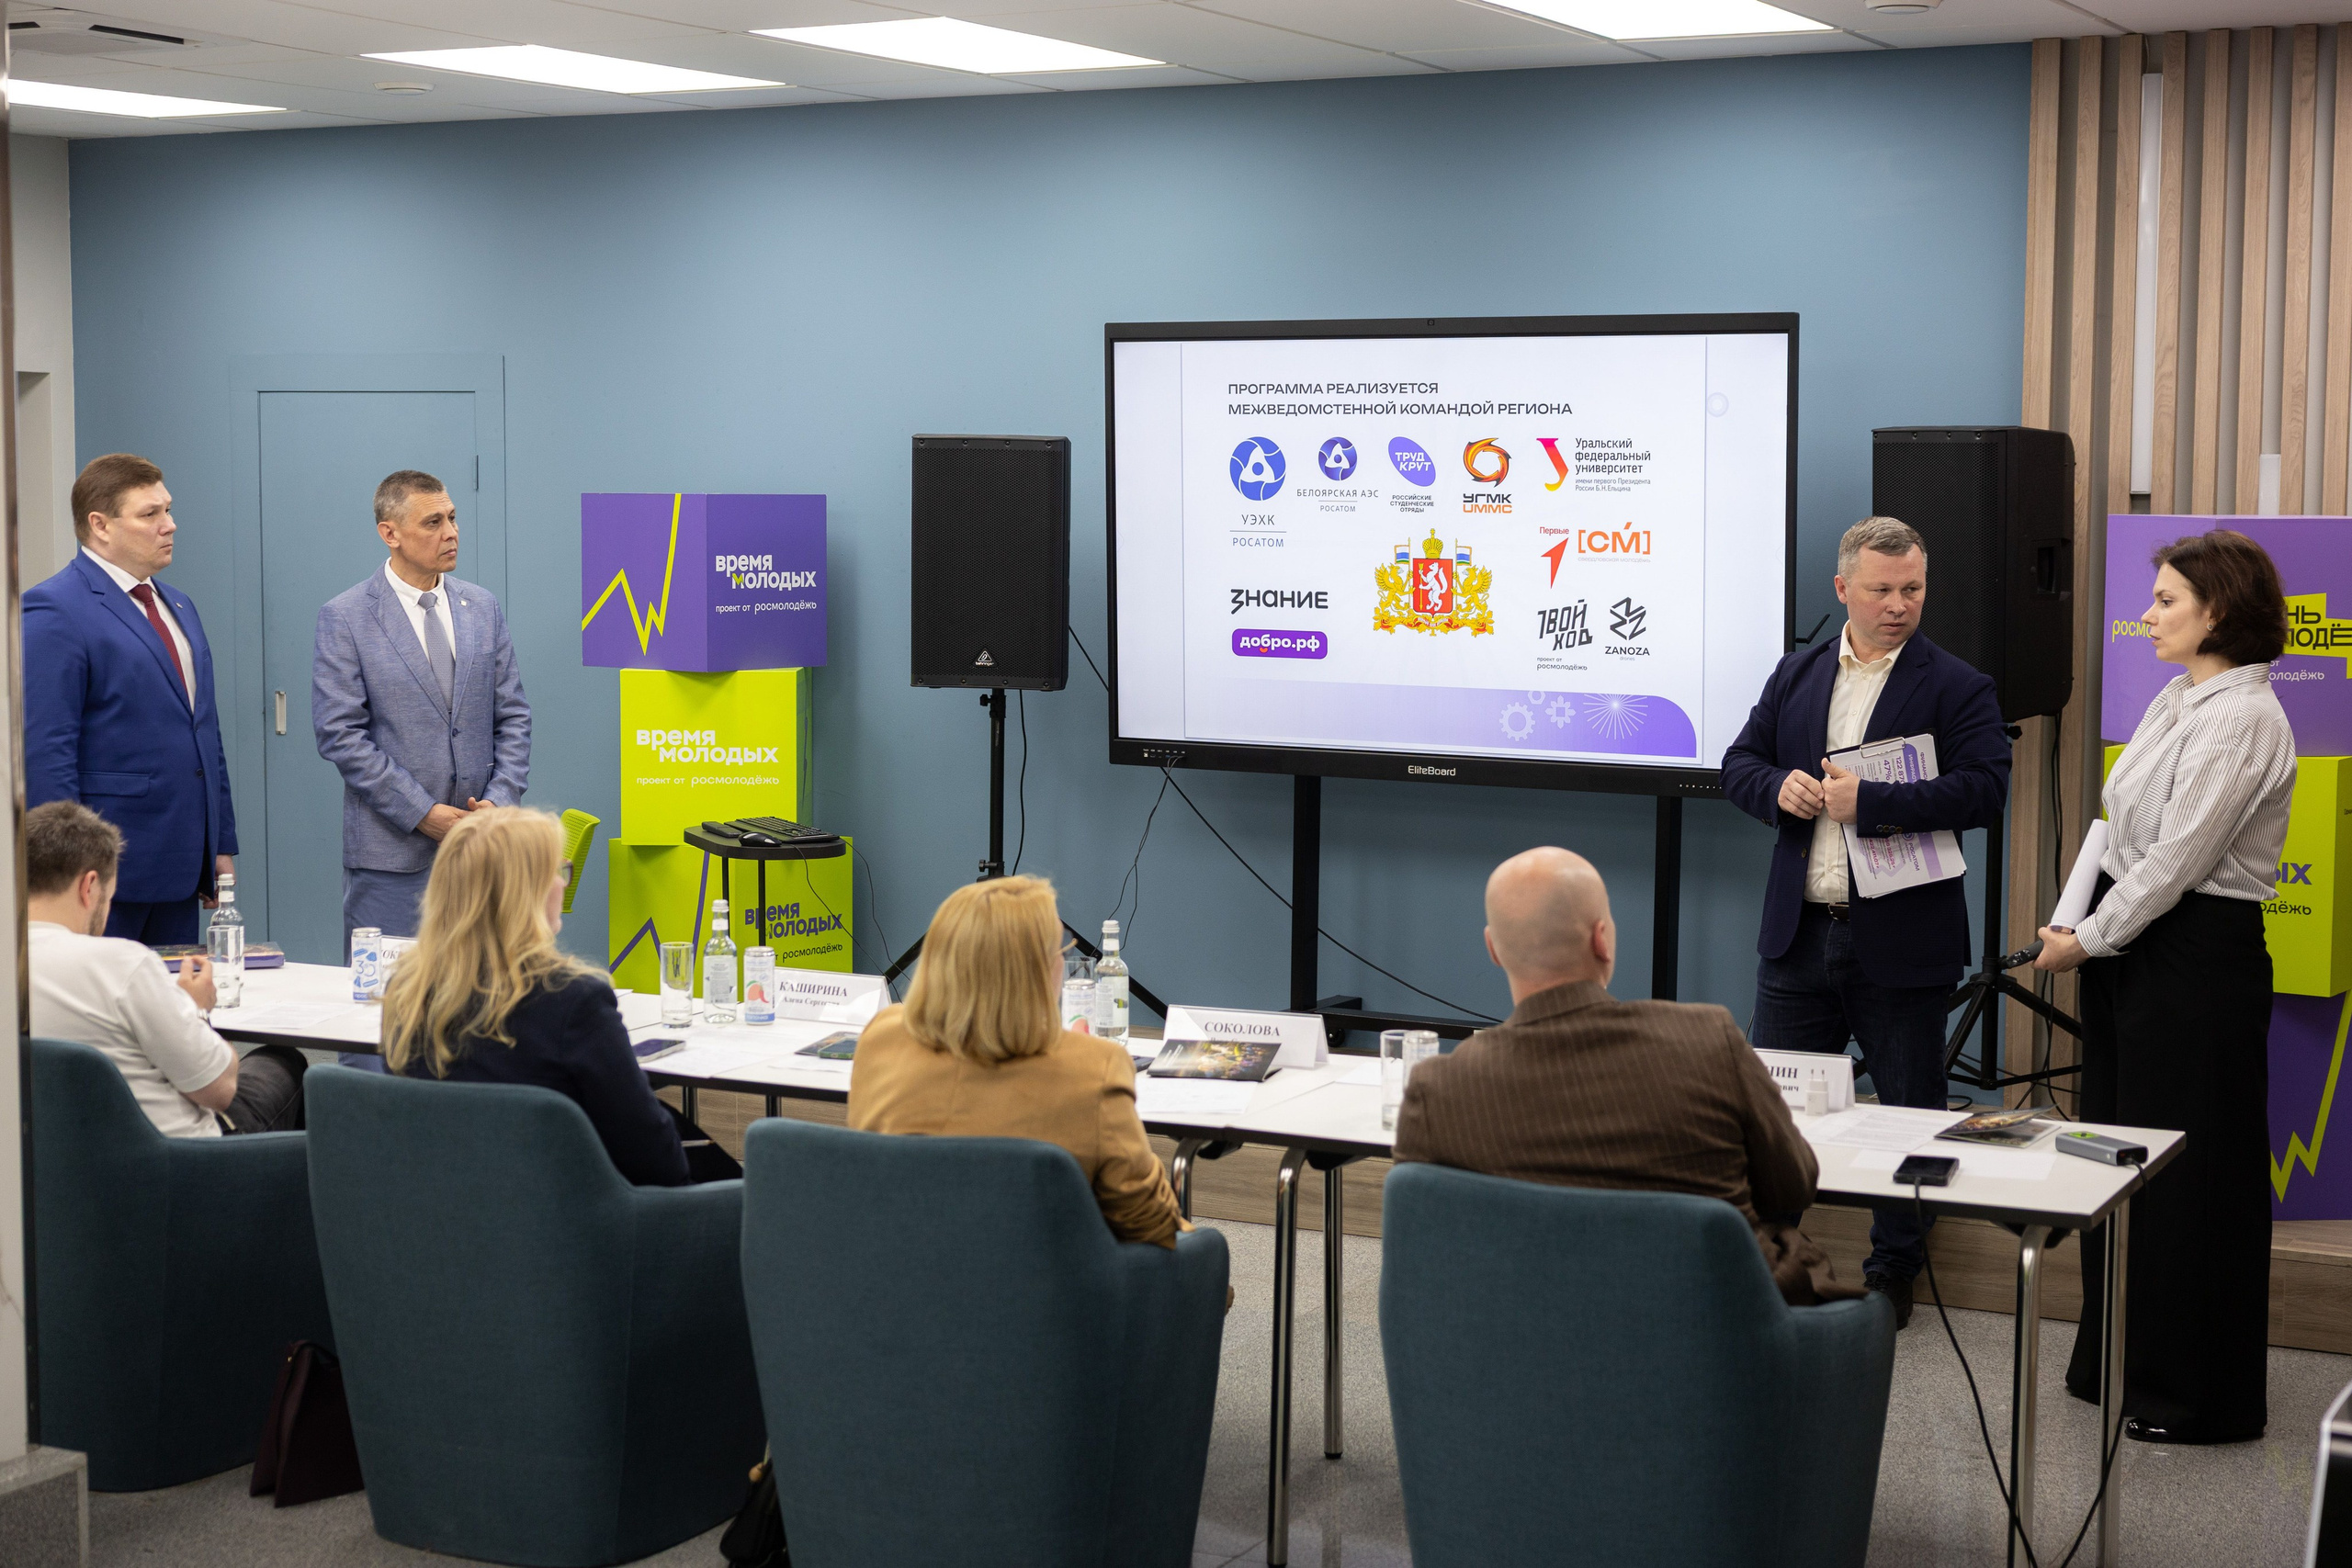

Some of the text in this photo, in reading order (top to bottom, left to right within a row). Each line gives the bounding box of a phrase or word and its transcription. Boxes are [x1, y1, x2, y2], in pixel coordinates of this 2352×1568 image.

[1228, 382, 1439, 395] ПРОГРАММА РЕАЛИЗУЕТСЯ
[1228, 400, 1573, 416] МЕЖВЕДОМСТЕННОЙ КОМАНДОЙ РЕГИОНА
[1575, 437, 1633, 450] Уральский
[1395, 451, 1425, 462] ТРУД
[1575, 451, 1651, 463] федеральный
[1399, 461, 1431, 472] КРУТ
[1575, 464, 1643, 475] университет
[1296, 489, 1379, 498] БЕЛОЯРСКАЯ АЭС
[1463, 493, 1512, 504] УГМК
[1463, 504, 1512, 513] UMMC
[1241, 514, 1275, 525] УЭХК
[1539, 526, 1570, 536] Первые
[1232, 537, 1284, 547] РОСАТОМ
[716, 555, 773, 577] время
[732, 571, 817, 591] молодых
[716, 604, 741, 614] проект
[754, 600, 817, 615] росмолодёжь
[1537, 599, 1588, 639] ТВОЙ
[1238, 632, 1321, 652] добро.рф
[1553, 628, 1593, 651] ХОД
[1604, 646, 1650, 656] ZANOZA
[1536, 663, 1588, 671] росмолодёжь
[636, 729, 716, 750] время
[659, 747, 779, 766] молодых
[1408, 764, 1456, 777] EliteBoard
[636, 776, 671, 786] проект
[691, 774, 780, 788] росмолодёжь
[782, 942, 843, 963] росмолодёжь
[779, 981, 847, 997] КАШИРИНА
[1204, 1021, 1281, 1036] СОКОЛОВА
